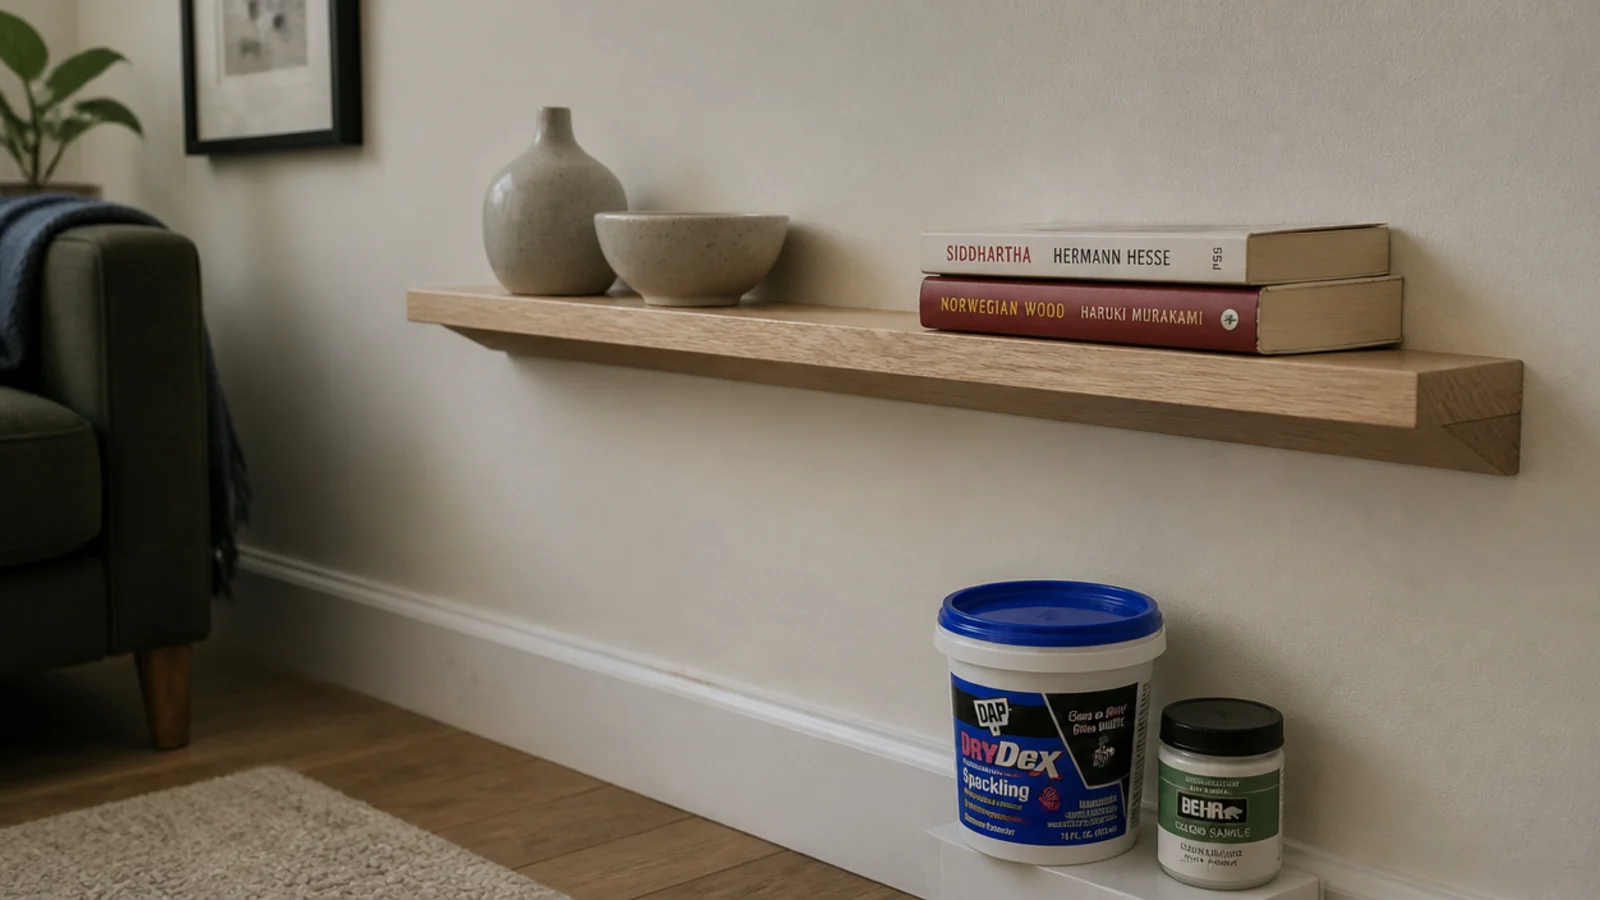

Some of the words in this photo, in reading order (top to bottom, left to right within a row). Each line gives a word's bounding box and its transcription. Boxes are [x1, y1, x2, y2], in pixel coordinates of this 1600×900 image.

[946, 244, 1031, 263] SIDDHARTHA
[1053, 247, 1121, 265] HERMANN
[1127, 249, 1171, 266] HESSE
[941, 297, 1018, 316] NORWEGIAN
[1024, 301, 1065, 319] WOOD
[1080, 305, 1126, 321] HARUKI
[1131, 308, 1203, 325] MURAKAMI
[977, 701, 1007, 724] DAP
[963, 767, 1029, 802] Spackling
